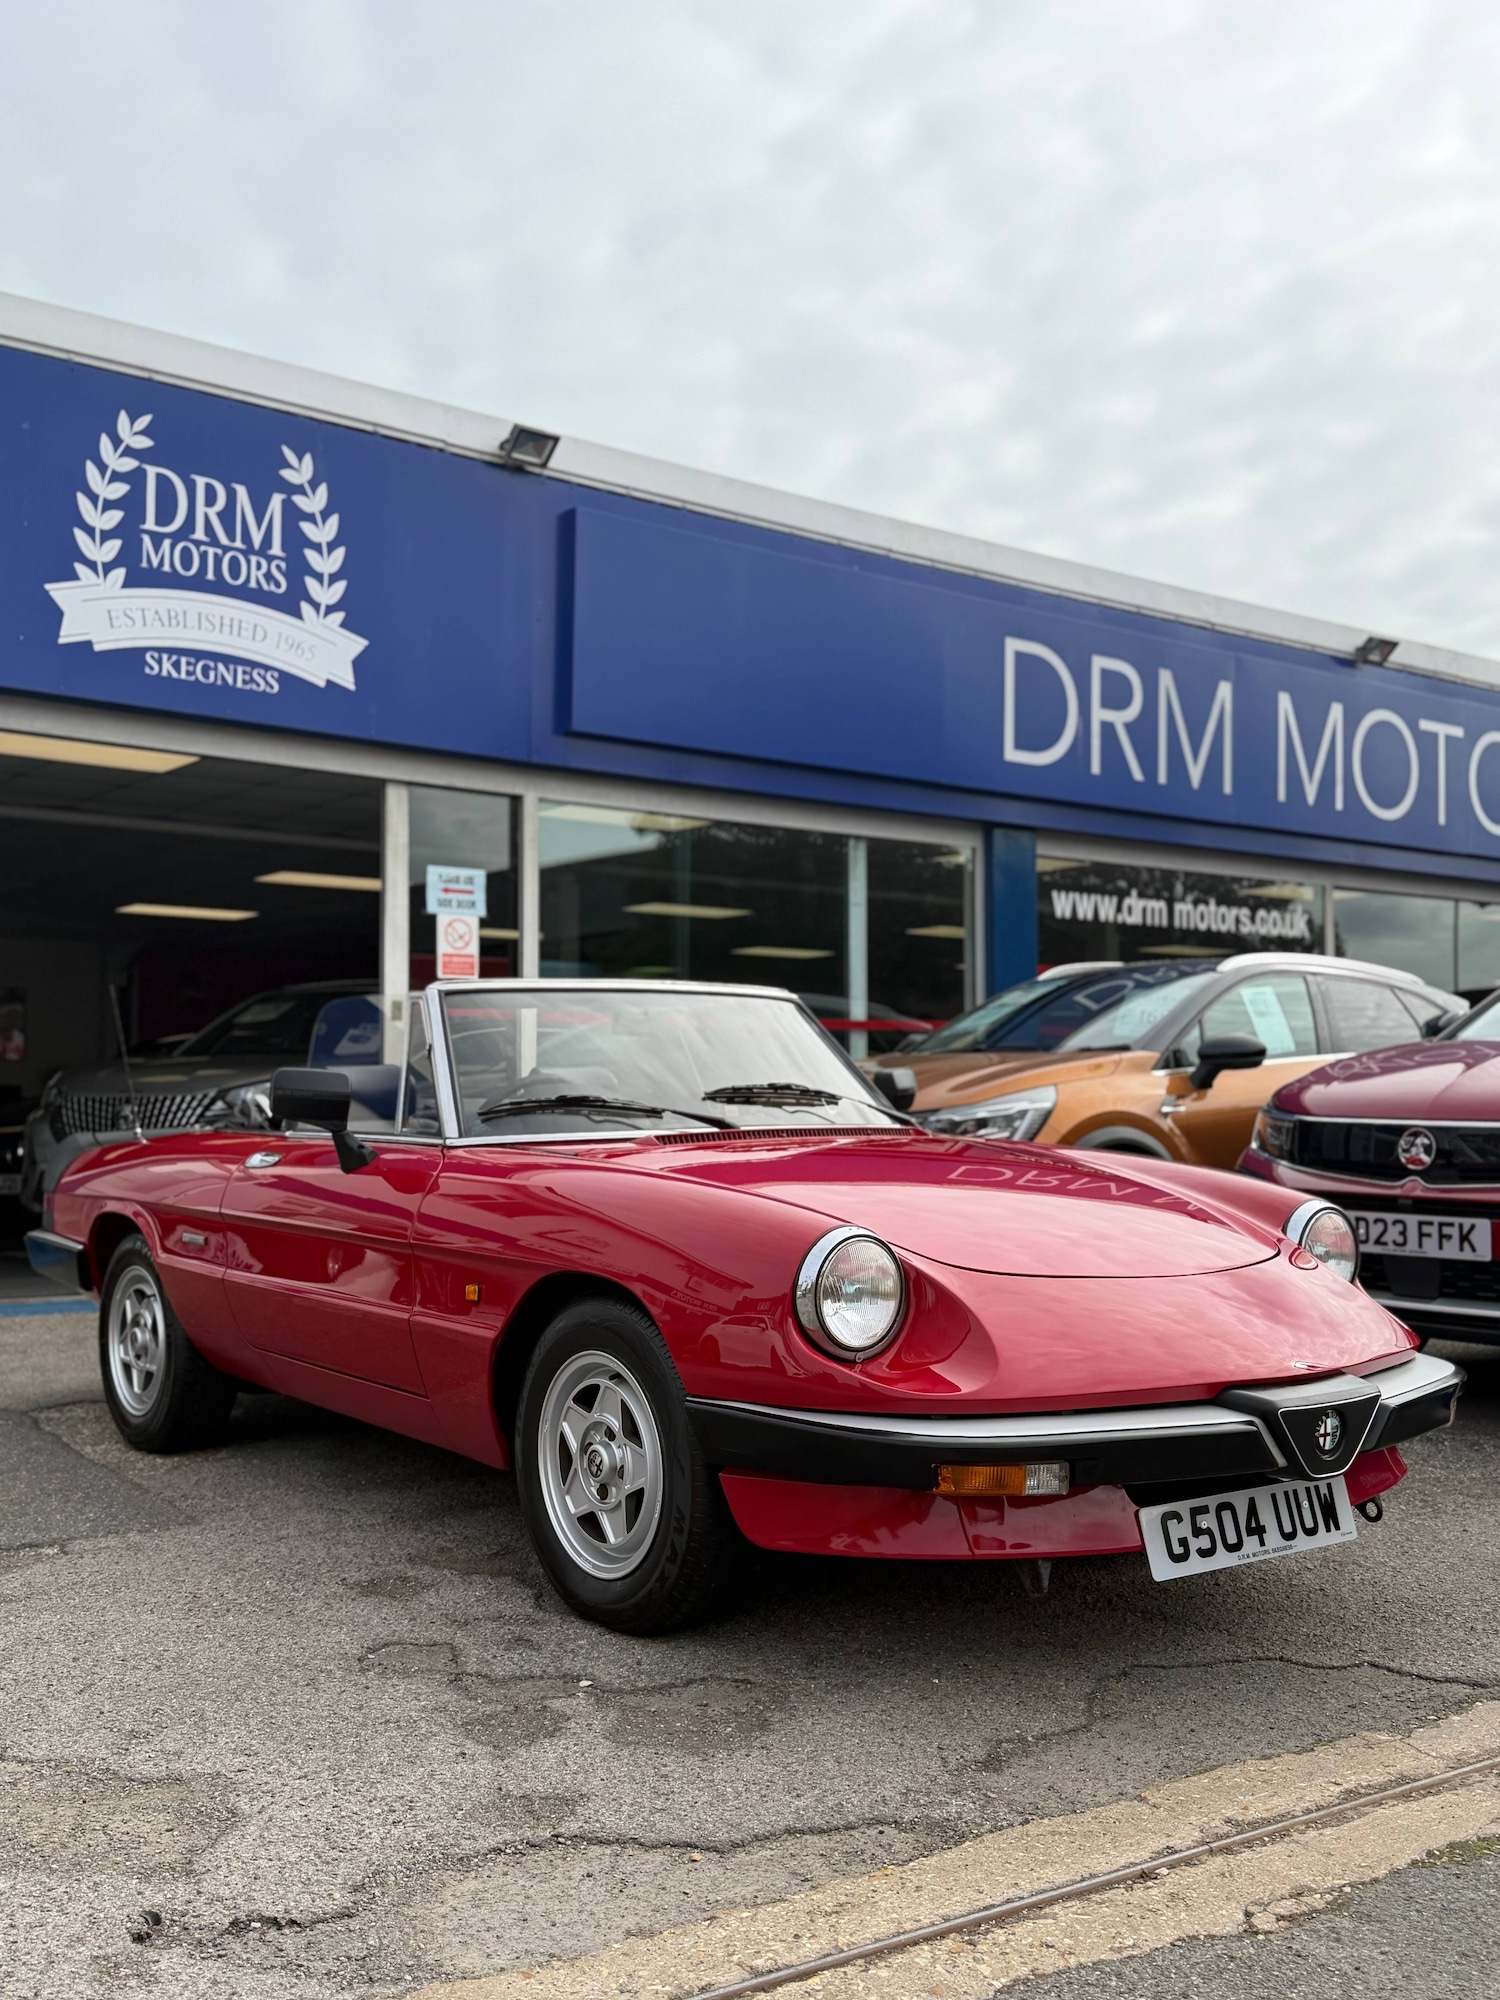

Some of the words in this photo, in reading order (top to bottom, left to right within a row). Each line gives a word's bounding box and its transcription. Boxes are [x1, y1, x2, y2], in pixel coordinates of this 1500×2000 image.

[139, 463, 287, 558] DRM
[139, 533, 288, 594] MOTORS
[106, 607, 268, 644] ESTABLISHED
[275, 631, 317, 663] 1965
[143, 650, 280, 695] SKEGNESS
[1003, 636, 1233, 796] DRM
[1417, 1220, 1477, 1253] FFK
[1160, 1496, 1267, 1564] G504
[1270, 1482, 1341, 1542] UUW
